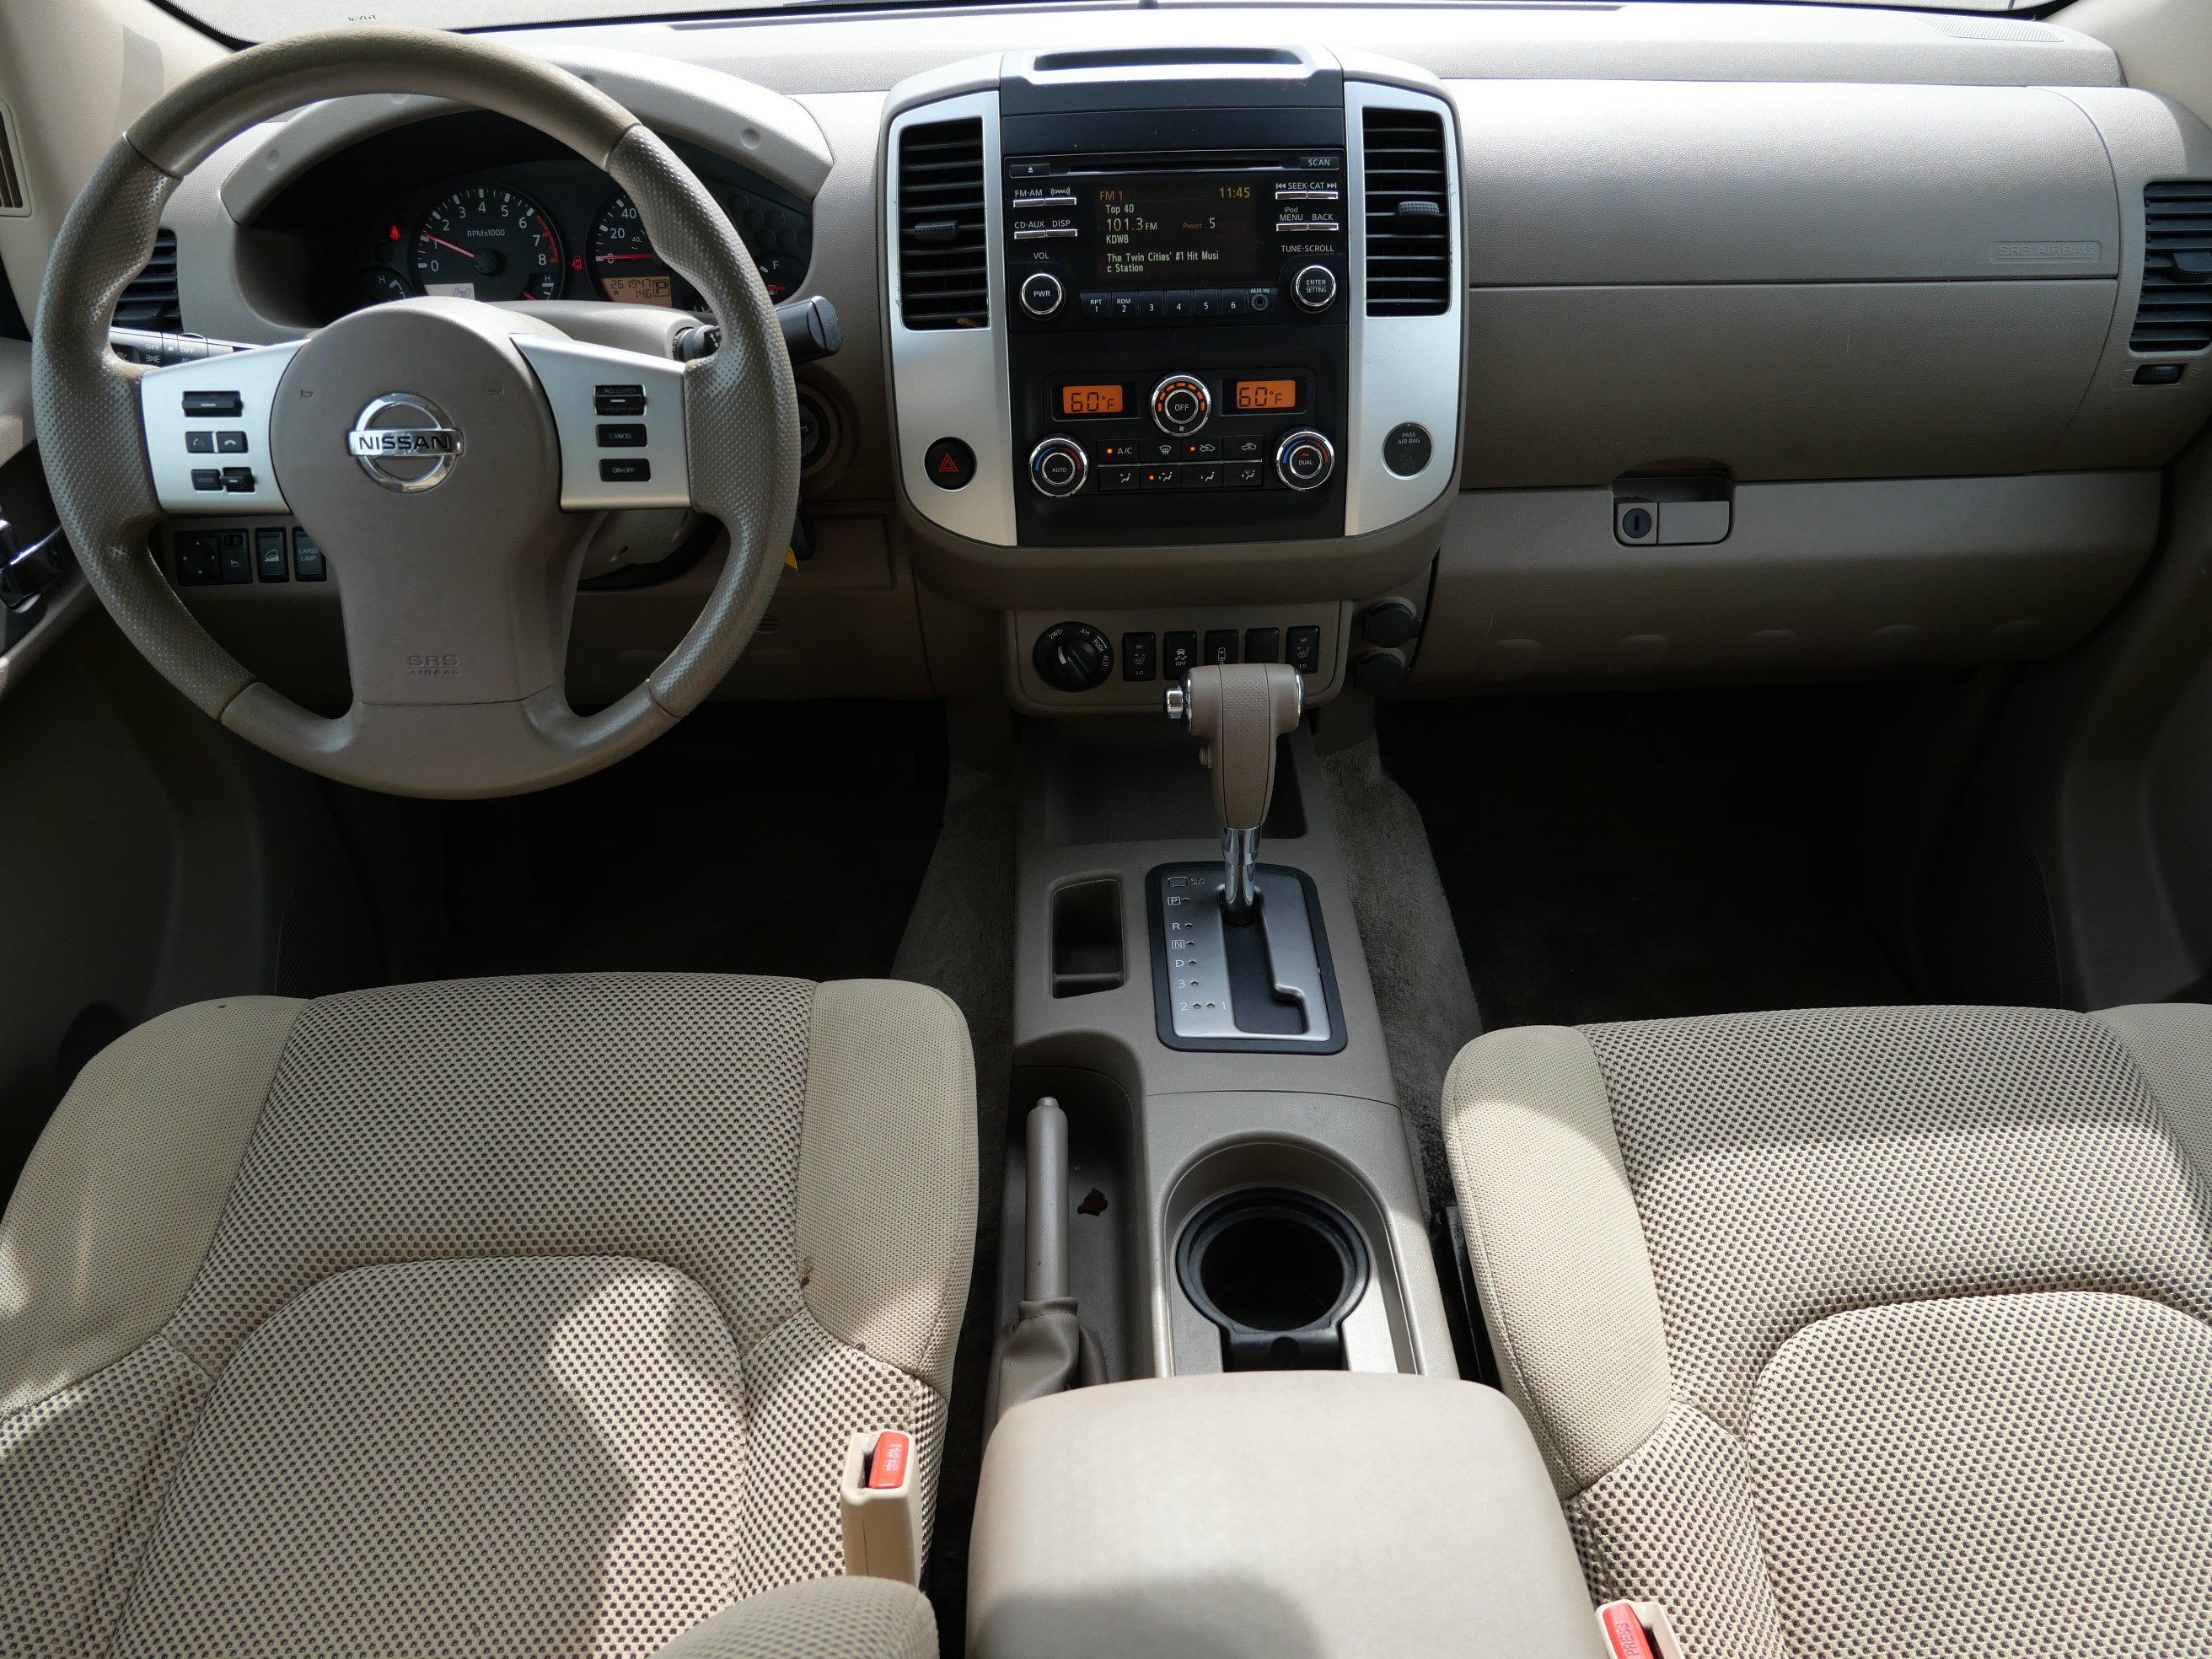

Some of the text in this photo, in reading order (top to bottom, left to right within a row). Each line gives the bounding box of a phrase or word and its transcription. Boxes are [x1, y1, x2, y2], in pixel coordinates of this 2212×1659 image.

[1099, 191, 1123, 201] FM 1
[1219, 186, 1250, 199] 11:45
[459, 207, 466, 219] 3
[478, 201, 487, 214] 4
[501, 205, 509, 217] 5
[1105, 203, 1135, 215] Top 40
[621, 208, 636, 219] 40
[442, 219, 450, 231] 2
[518, 217, 528, 229] 6
[1052, 219, 1071, 228] DISP
[1106, 217, 1157, 232] 101.3 FM
[1209, 217, 1216, 229] 5
[467, 228, 506, 238] RPMx1000
[610, 228, 625, 239] 20
[532, 234, 541, 247] 7
[1106, 234, 1129, 244] KDWB
[1997, 244, 2094, 255] SRS AIRBAG
[538, 253, 547, 266] 8
[1107, 250, 1219, 263] The Twin Cities' #1 Hit Musi
[431, 260, 439, 272] 0
[773, 260, 779, 270] F
[1115, 263, 1143, 273] Station
[379, 275, 386, 284] H
[654, 281, 668, 295] P
[1174, 403, 1189, 412] OFF
[358, 435, 448, 451] NISSAN
[1117, 446, 1133, 456] A/C
[1048, 629, 1063, 640] 2WD
[1093, 638, 1104, 652] PUSH
[408, 655, 459, 666] SRS
[1172, 922, 1180, 931] R
[1175, 959, 1184, 968] D
[1178, 980, 1185, 989] 3
[1180, 1001, 1226, 1011] 2 1
